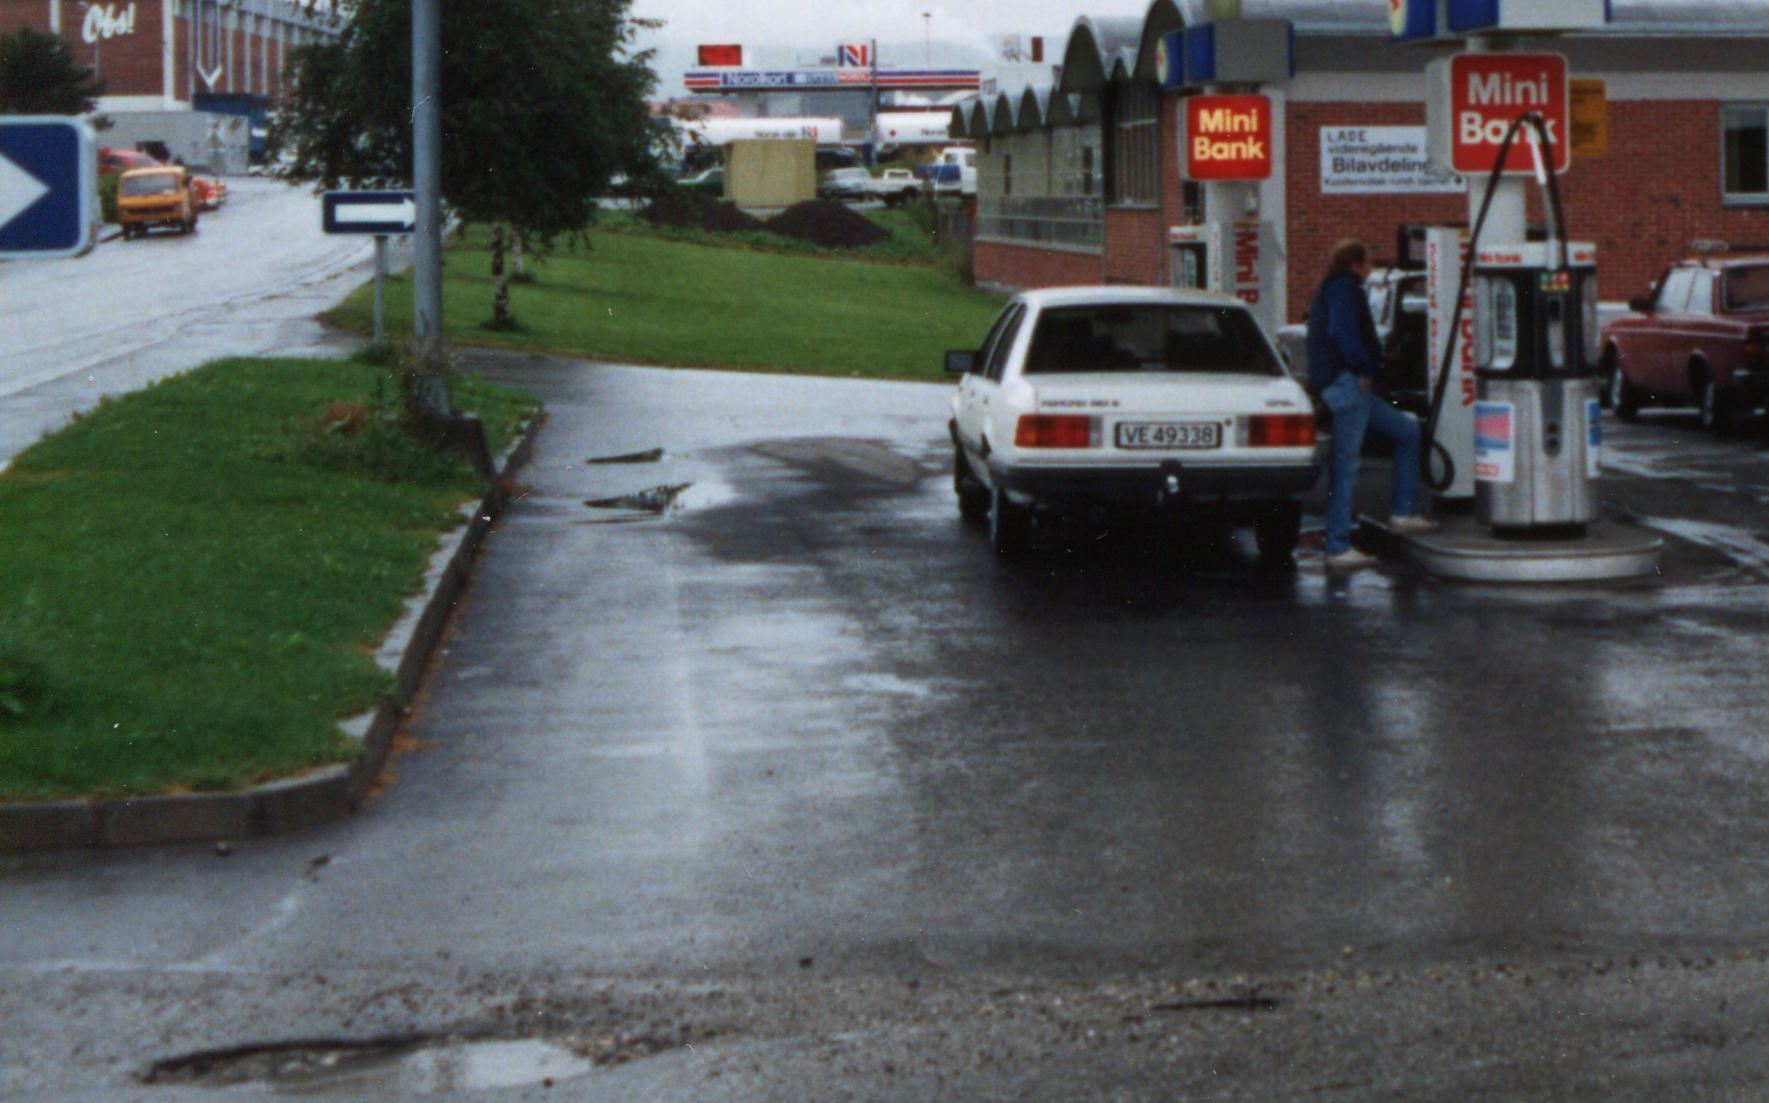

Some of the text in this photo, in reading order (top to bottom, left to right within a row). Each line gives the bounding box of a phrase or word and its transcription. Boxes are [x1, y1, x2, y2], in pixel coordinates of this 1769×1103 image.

[1468, 72, 1548, 105] Mini
[1199, 108, 1259, 133] Mini
[1193, 135, 1264, 160] Bank
[1124, 426, 1214, 444] VE 49338
